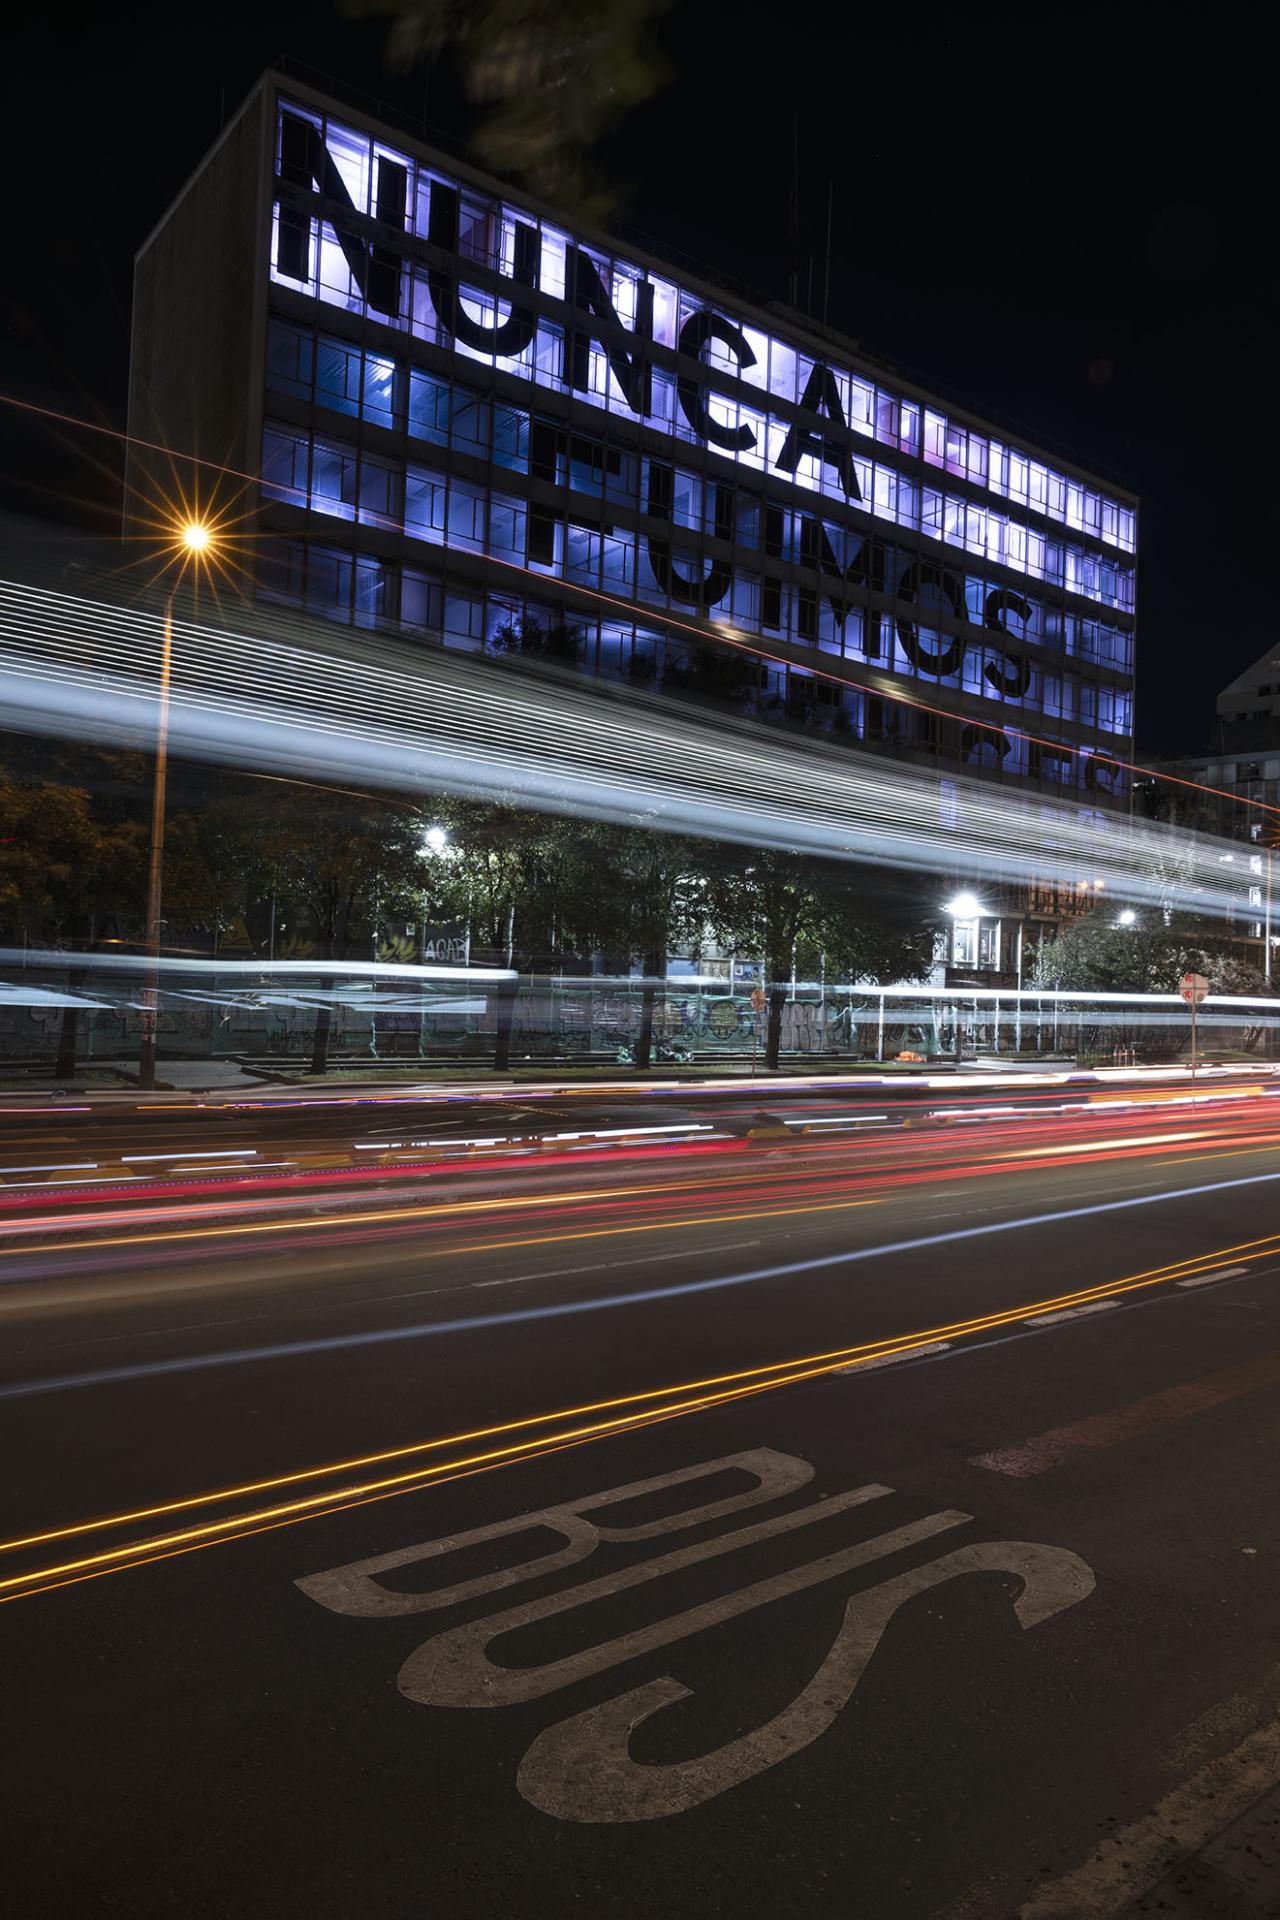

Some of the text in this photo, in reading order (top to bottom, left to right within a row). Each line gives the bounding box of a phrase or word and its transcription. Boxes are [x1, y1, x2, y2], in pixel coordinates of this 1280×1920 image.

[277, 109, 862, 502] NUNCA
[529, 416, 1032, 698] FUIMOS
[293, 1447, 1096, 1824] BUS
